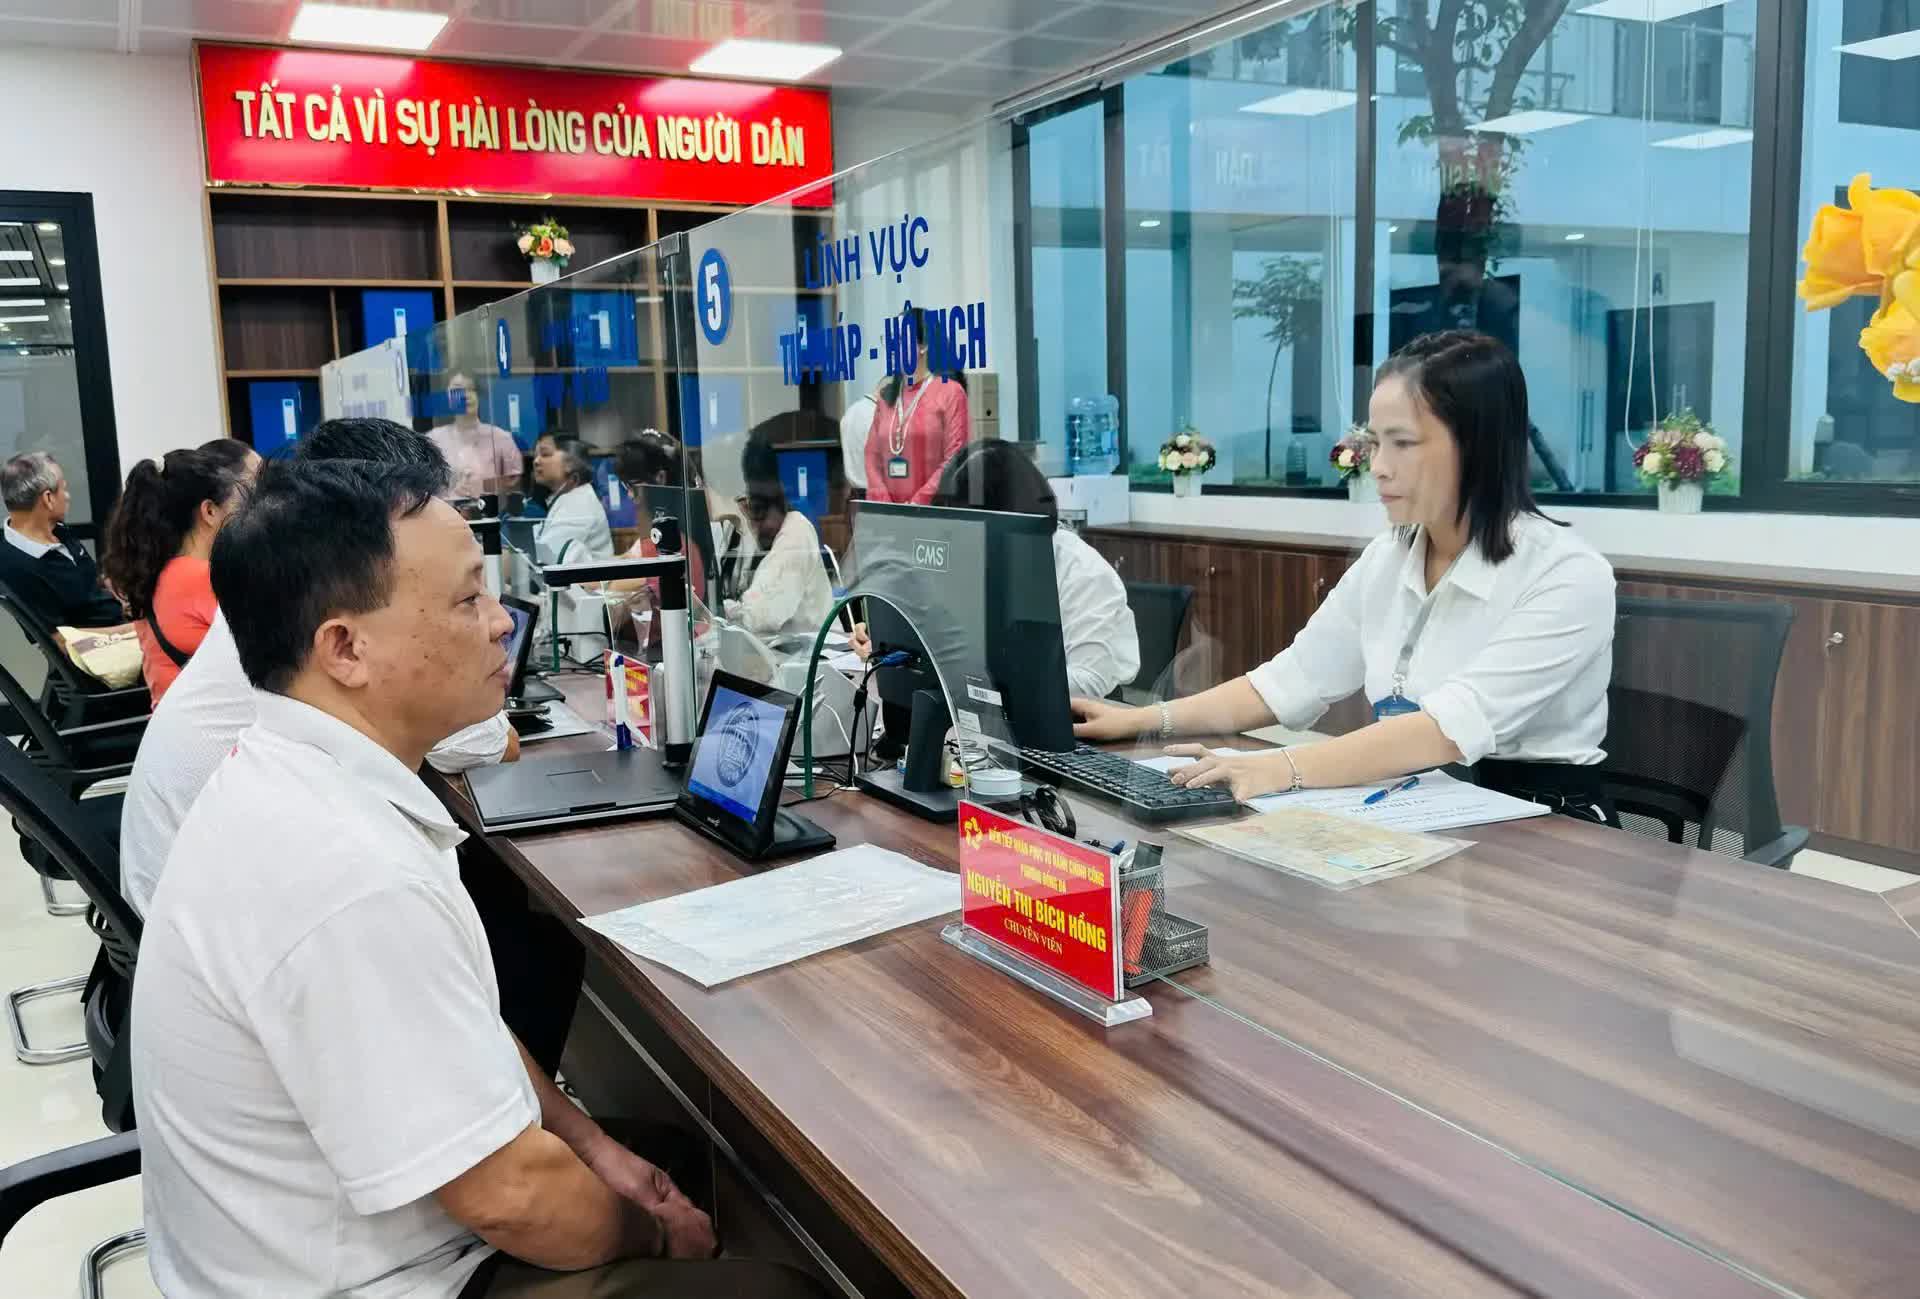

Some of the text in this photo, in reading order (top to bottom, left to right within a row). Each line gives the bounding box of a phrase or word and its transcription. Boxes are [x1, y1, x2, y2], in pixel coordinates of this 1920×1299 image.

[235, 78, 805, 166] TẤT CẢ VÌ SỰ HÀI LÒNG CỦA NGƯỜI DÂN
[803, 213, 929, 289] LĨNH VỰC
[705, 262, 721, 331] 5
[499, 326, 508, 370] 4
[870, 348, 878, 360] -
[884, 299, 918, 386] HỘ
[925, 301, 987, 384] TỊCH
[916, 544, 944, 566] CMS
[1003, 917, 1063, 956] CHUYÊN VIÊN
[1014, 890, 1033, 924] THỊ
[1036, 899, 1066, 935] BÍCH
[1068, 911, 1107, 953] HỒNG
